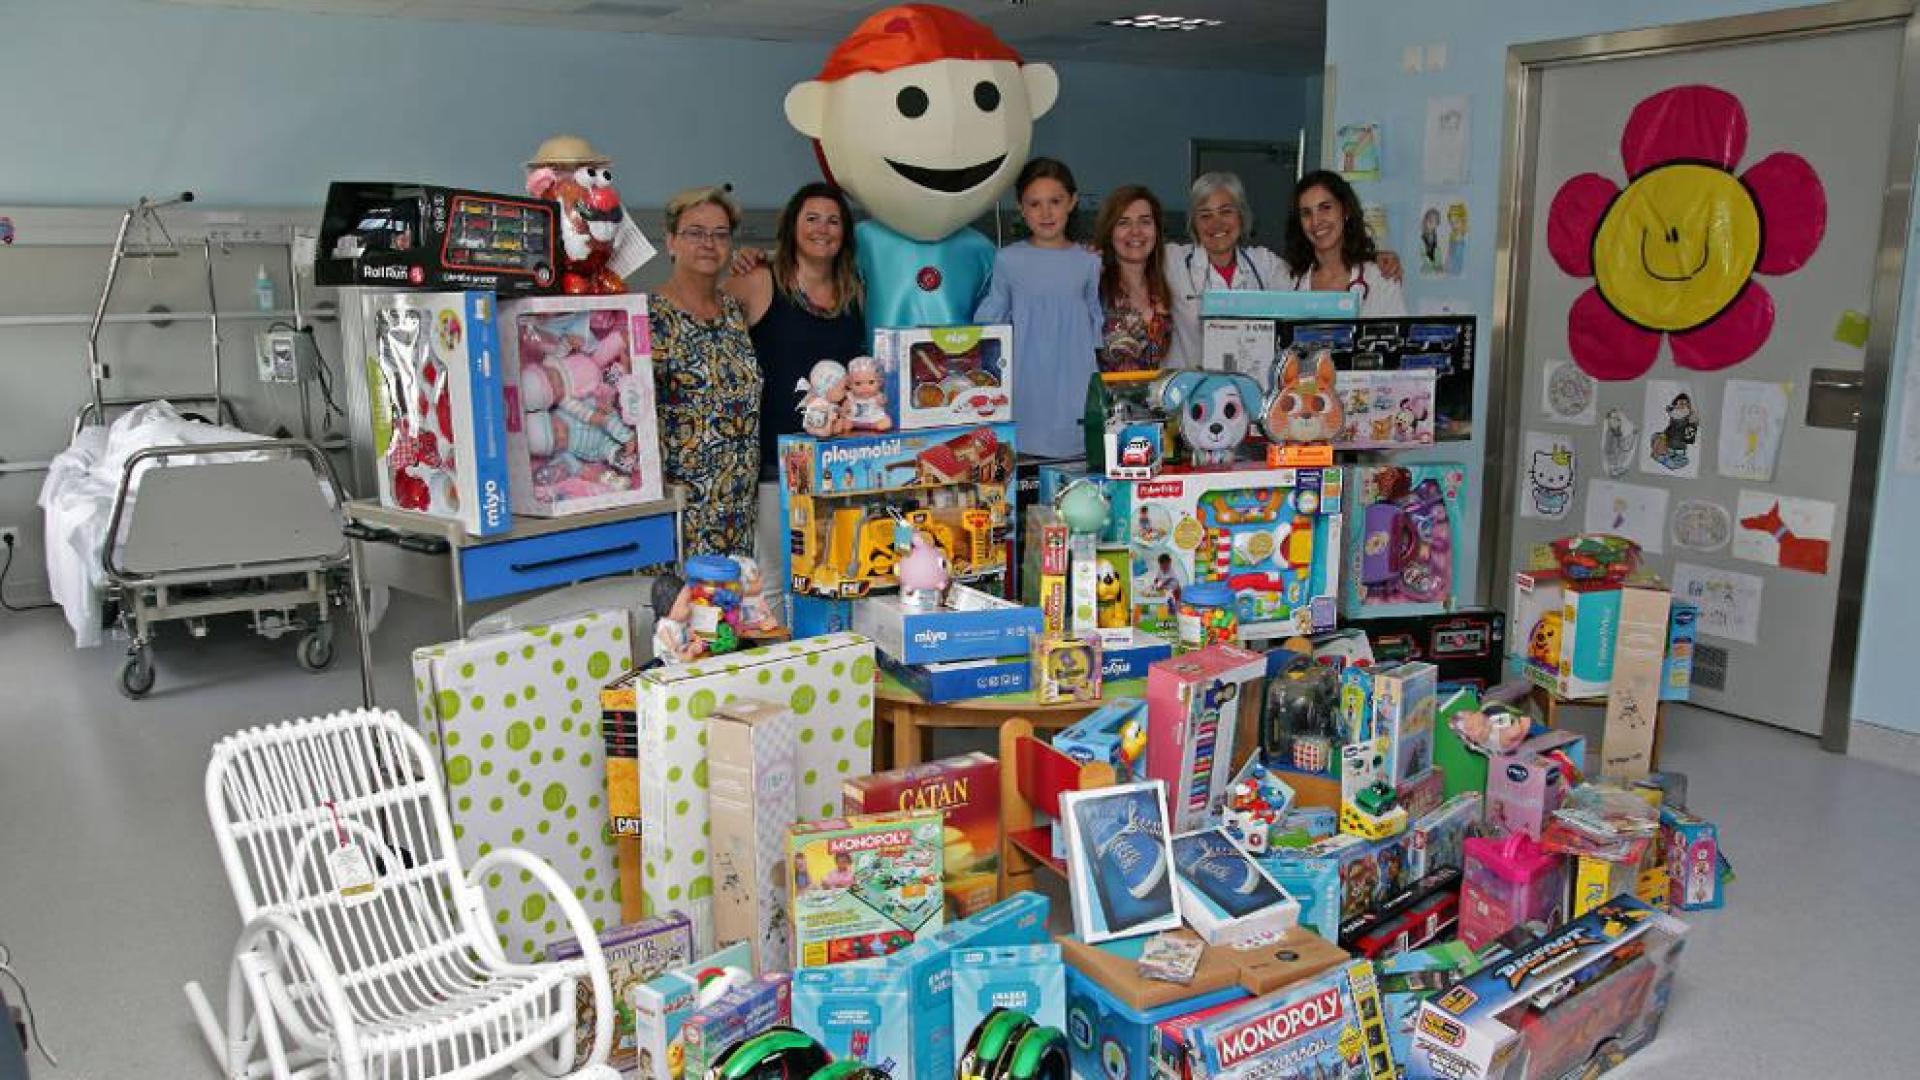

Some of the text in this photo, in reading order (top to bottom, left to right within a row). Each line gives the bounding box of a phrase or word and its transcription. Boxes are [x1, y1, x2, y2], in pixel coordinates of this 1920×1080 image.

[822, 439, 901, 466] playmobil
[899, 777, 969, 815] CATAN
[831, 831, 909, 852] MONOPOLY
[1221, 990, 1337, 1064] MONOPOLY
